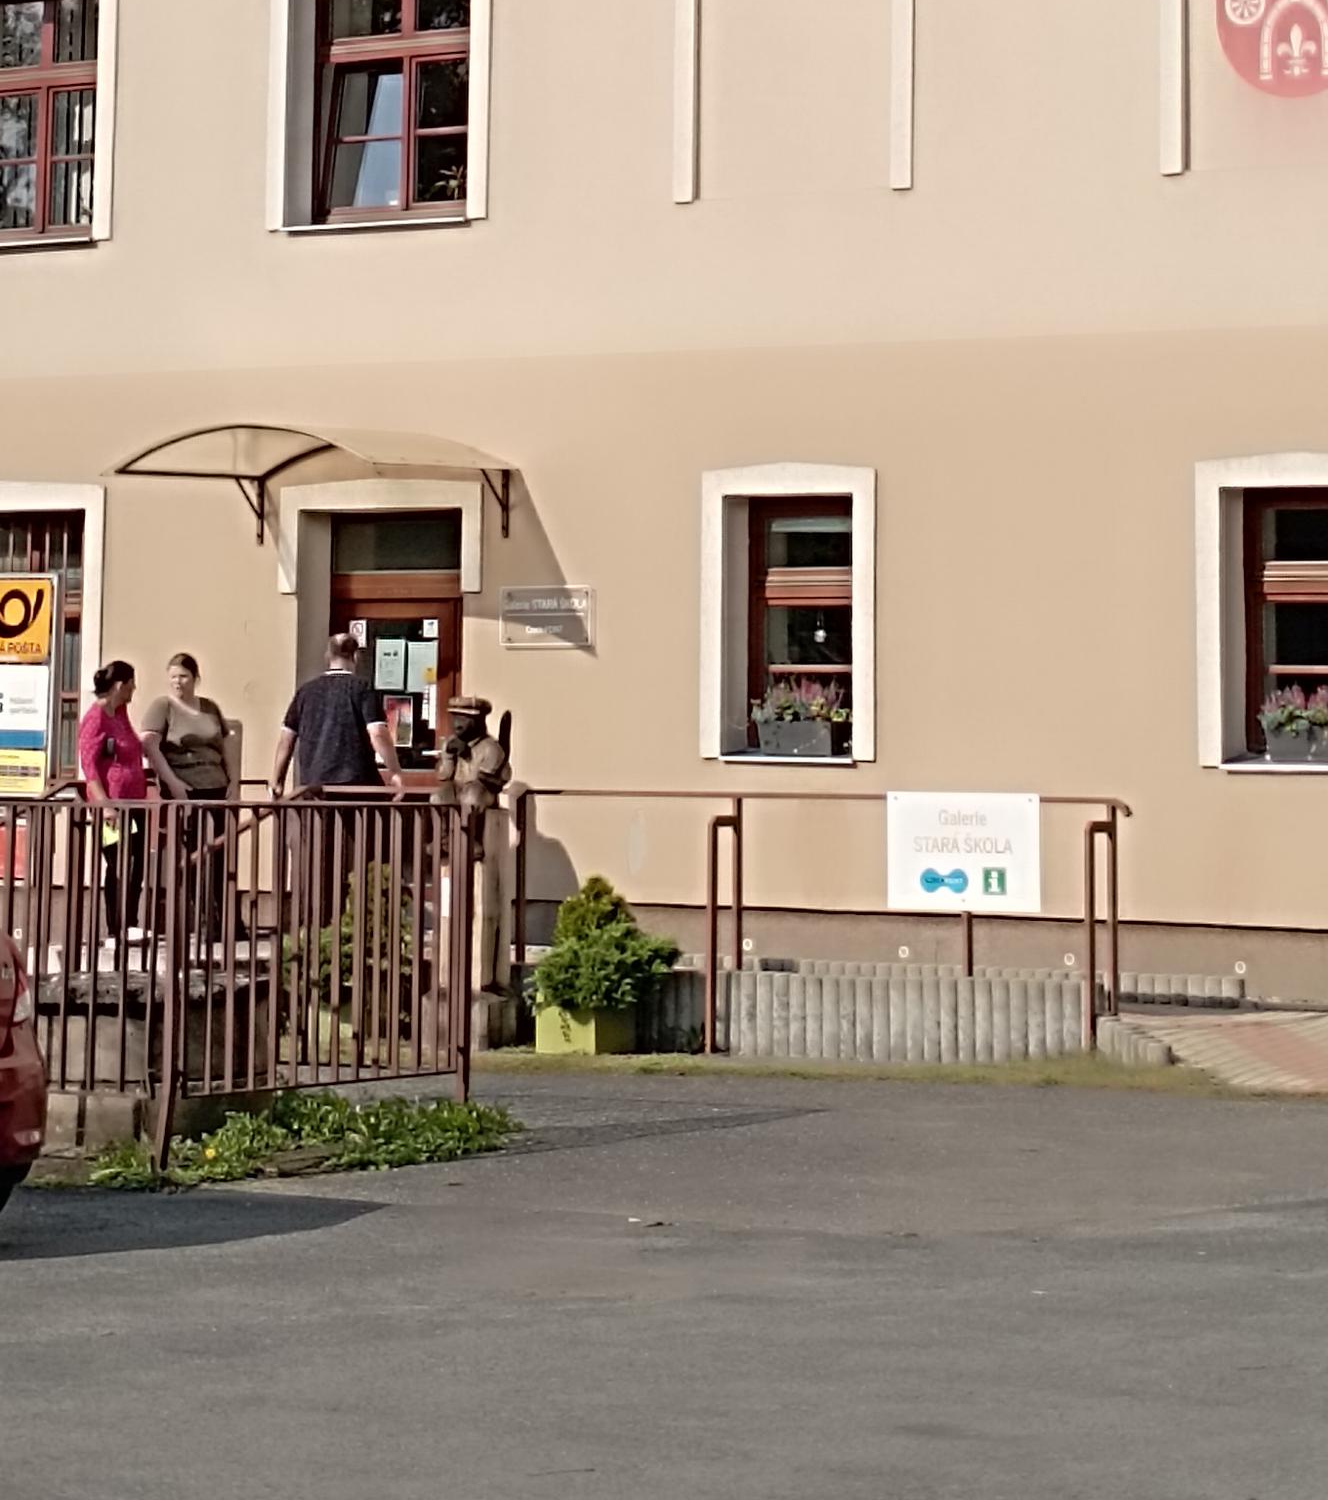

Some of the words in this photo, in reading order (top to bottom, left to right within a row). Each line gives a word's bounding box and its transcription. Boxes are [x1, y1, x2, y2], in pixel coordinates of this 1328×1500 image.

[8, 641, 42, 655] POŠTA
[938, 809, 987, 826] Galerie
[913, 833, 961, 853] STARÁ
[963, 833, 1013, 854] ŠKOLA
